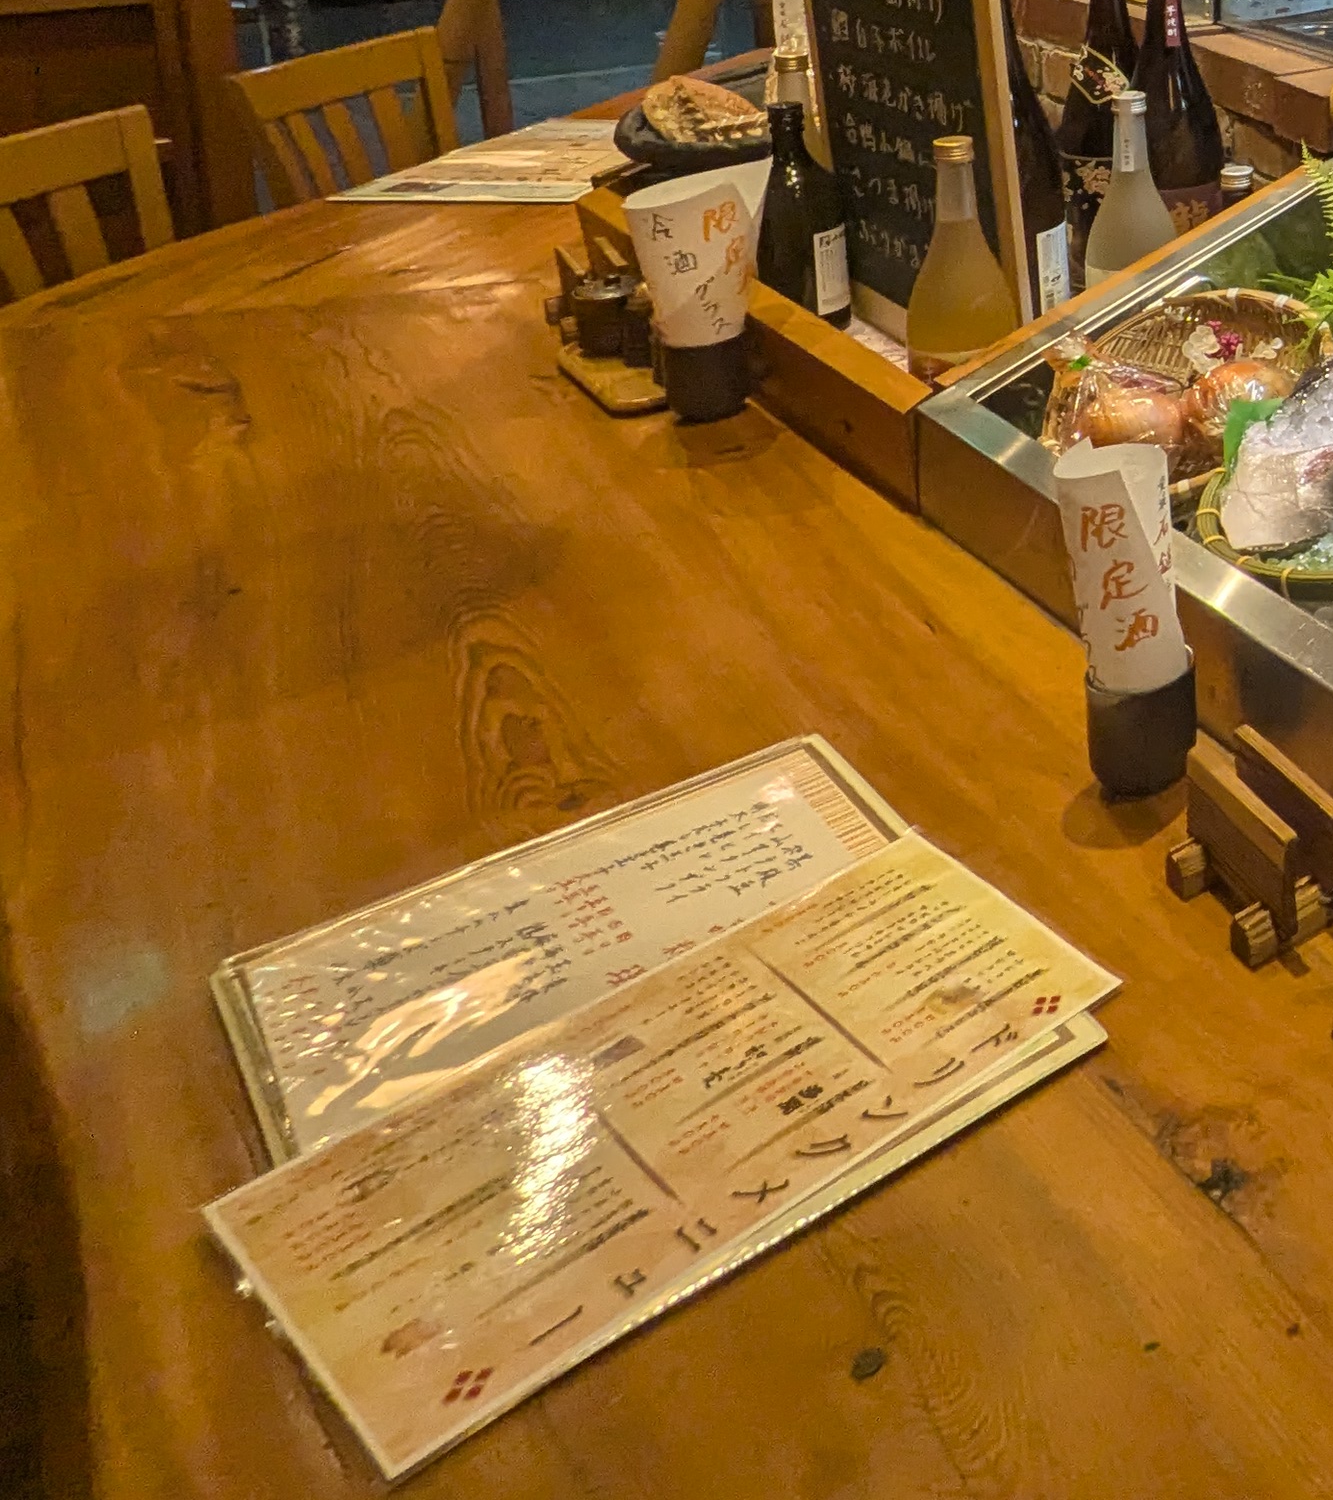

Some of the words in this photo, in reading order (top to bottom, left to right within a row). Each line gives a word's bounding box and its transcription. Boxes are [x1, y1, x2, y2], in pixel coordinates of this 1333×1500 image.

[1080, 503, 1160, 653] 限定酒
[527, 1022, 1020, 1346] ドリンクメニュー
